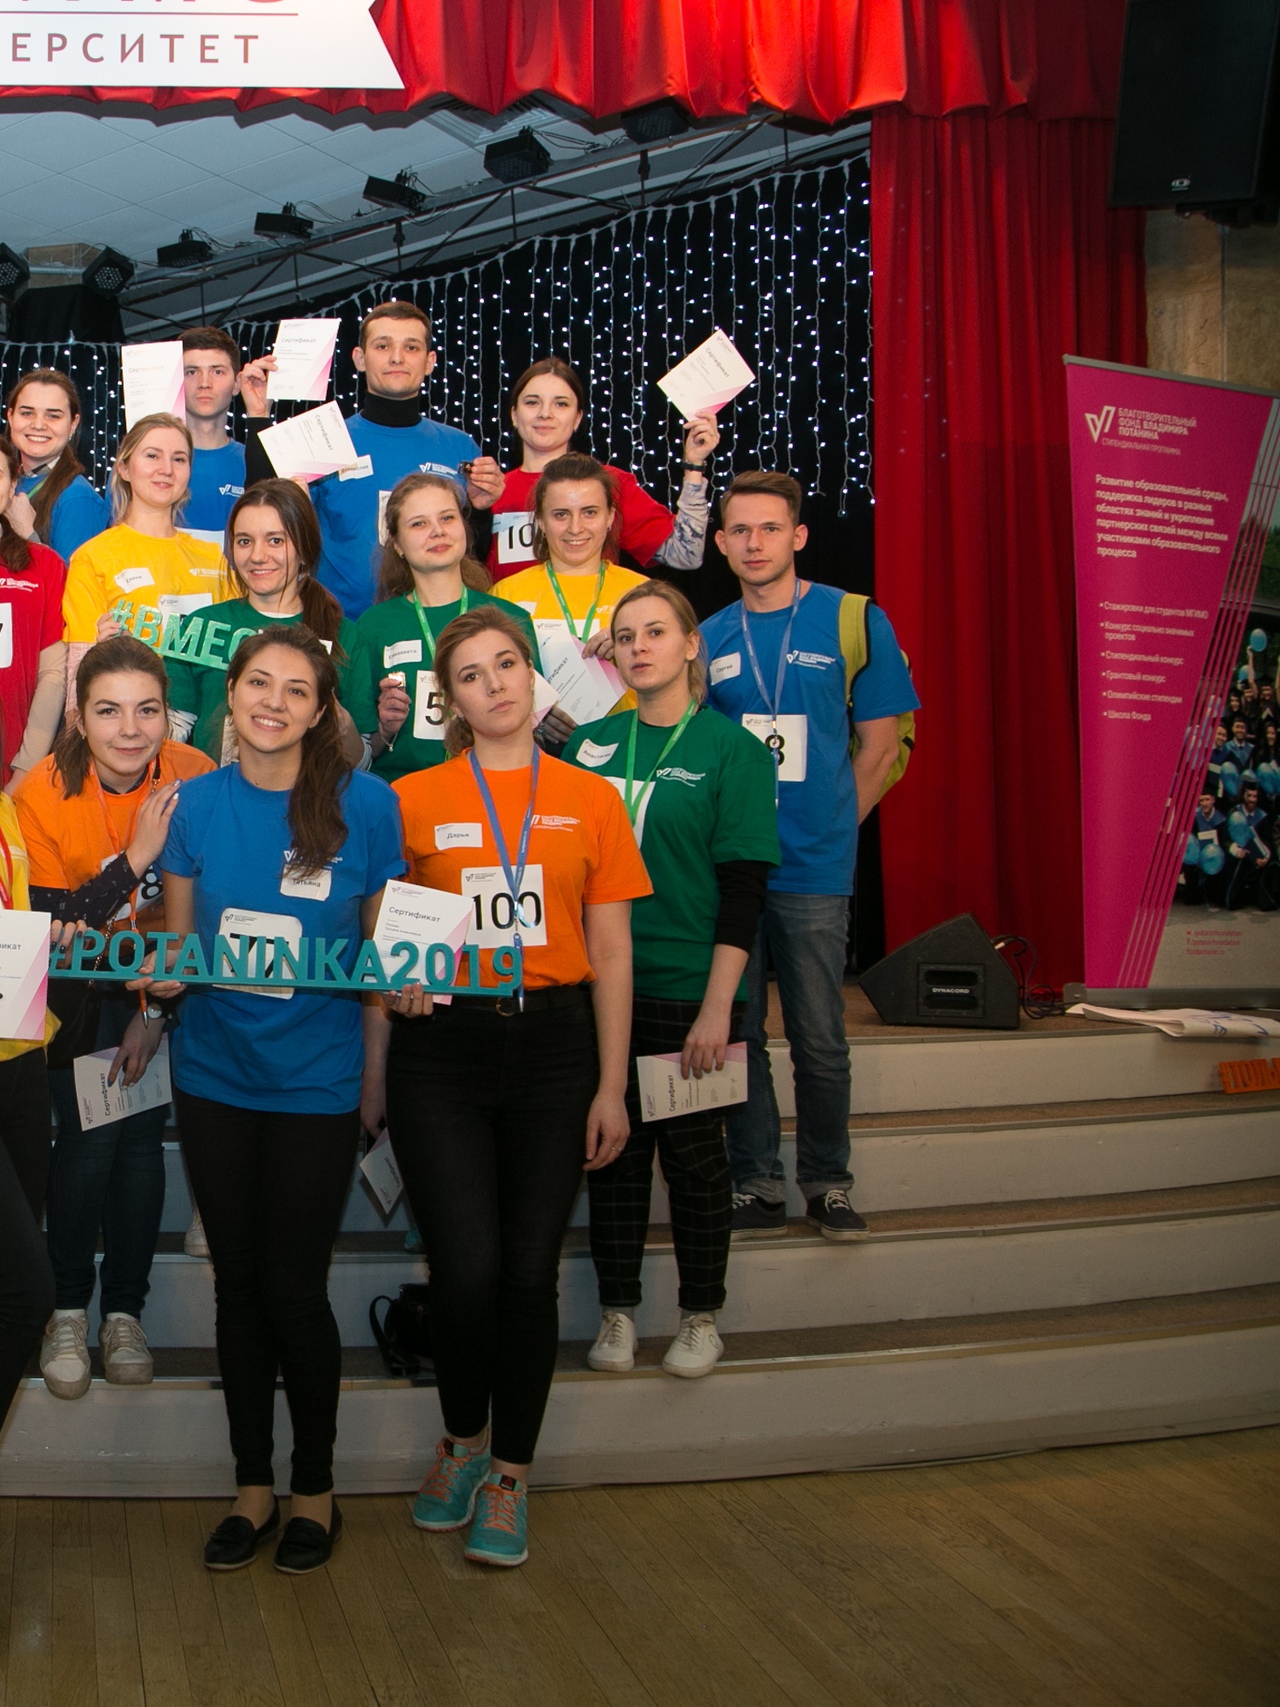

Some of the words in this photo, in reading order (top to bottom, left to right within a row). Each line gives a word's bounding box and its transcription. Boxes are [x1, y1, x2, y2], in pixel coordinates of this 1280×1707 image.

[1118, 407, 1197, 428] БЛАГОТВОРИТЕЛЬНЫЙ
[1118, 417, 1141, 429] ФОНД
[1142, 420, 1189, 436] ВЛАДИМИРА
[1118, 426, 1159, 441] ПОТАНИНА
[1096, 474, 1134, 489] Развитие
[1135, 480, 1201, 497] образовательной
[1202, 489, 1229, 502] среды,
[1096, 489, 1143, 504] поддержка
[1144, 495, 1177, 509] лидеров
[1183, 501, 1213, 513] разных
[1096, 503, 1134, 517] областях
[1135, 508, 1163, 520] знаний
[1170, 514, 1214, 526] укрепление
[1096, 518, 1149, 533] партнерских
[1149, 523, 1176, 535] связей
[1177, 528, 1204, 541] между
[1204, 531, 1228, 542] всеми
[1097, 533, 1151, 547] участниками
[1151, 537, 1221, 555] образовательного
[1097, 546, 1137, 559] процесса
[1104, 621, 1132, 632] Конкурс
[1105, 632, 1136, 641] проектов
[1106, 670, 1141, 681] Грантовый
[1107, 709, 1131, 719] Школа
[1131, 711, 1152, 722] Фонда
[446, 831, 470, 841] Дарья
[388, 906, 441, 923] Сертификат
[472, 890, 543, 931] 100
[931, 987, 970, 995] DYNACORD
[99, 1072, 111, 1117] Сертификат
[667, 1074, 677, 1112] Сертификат
